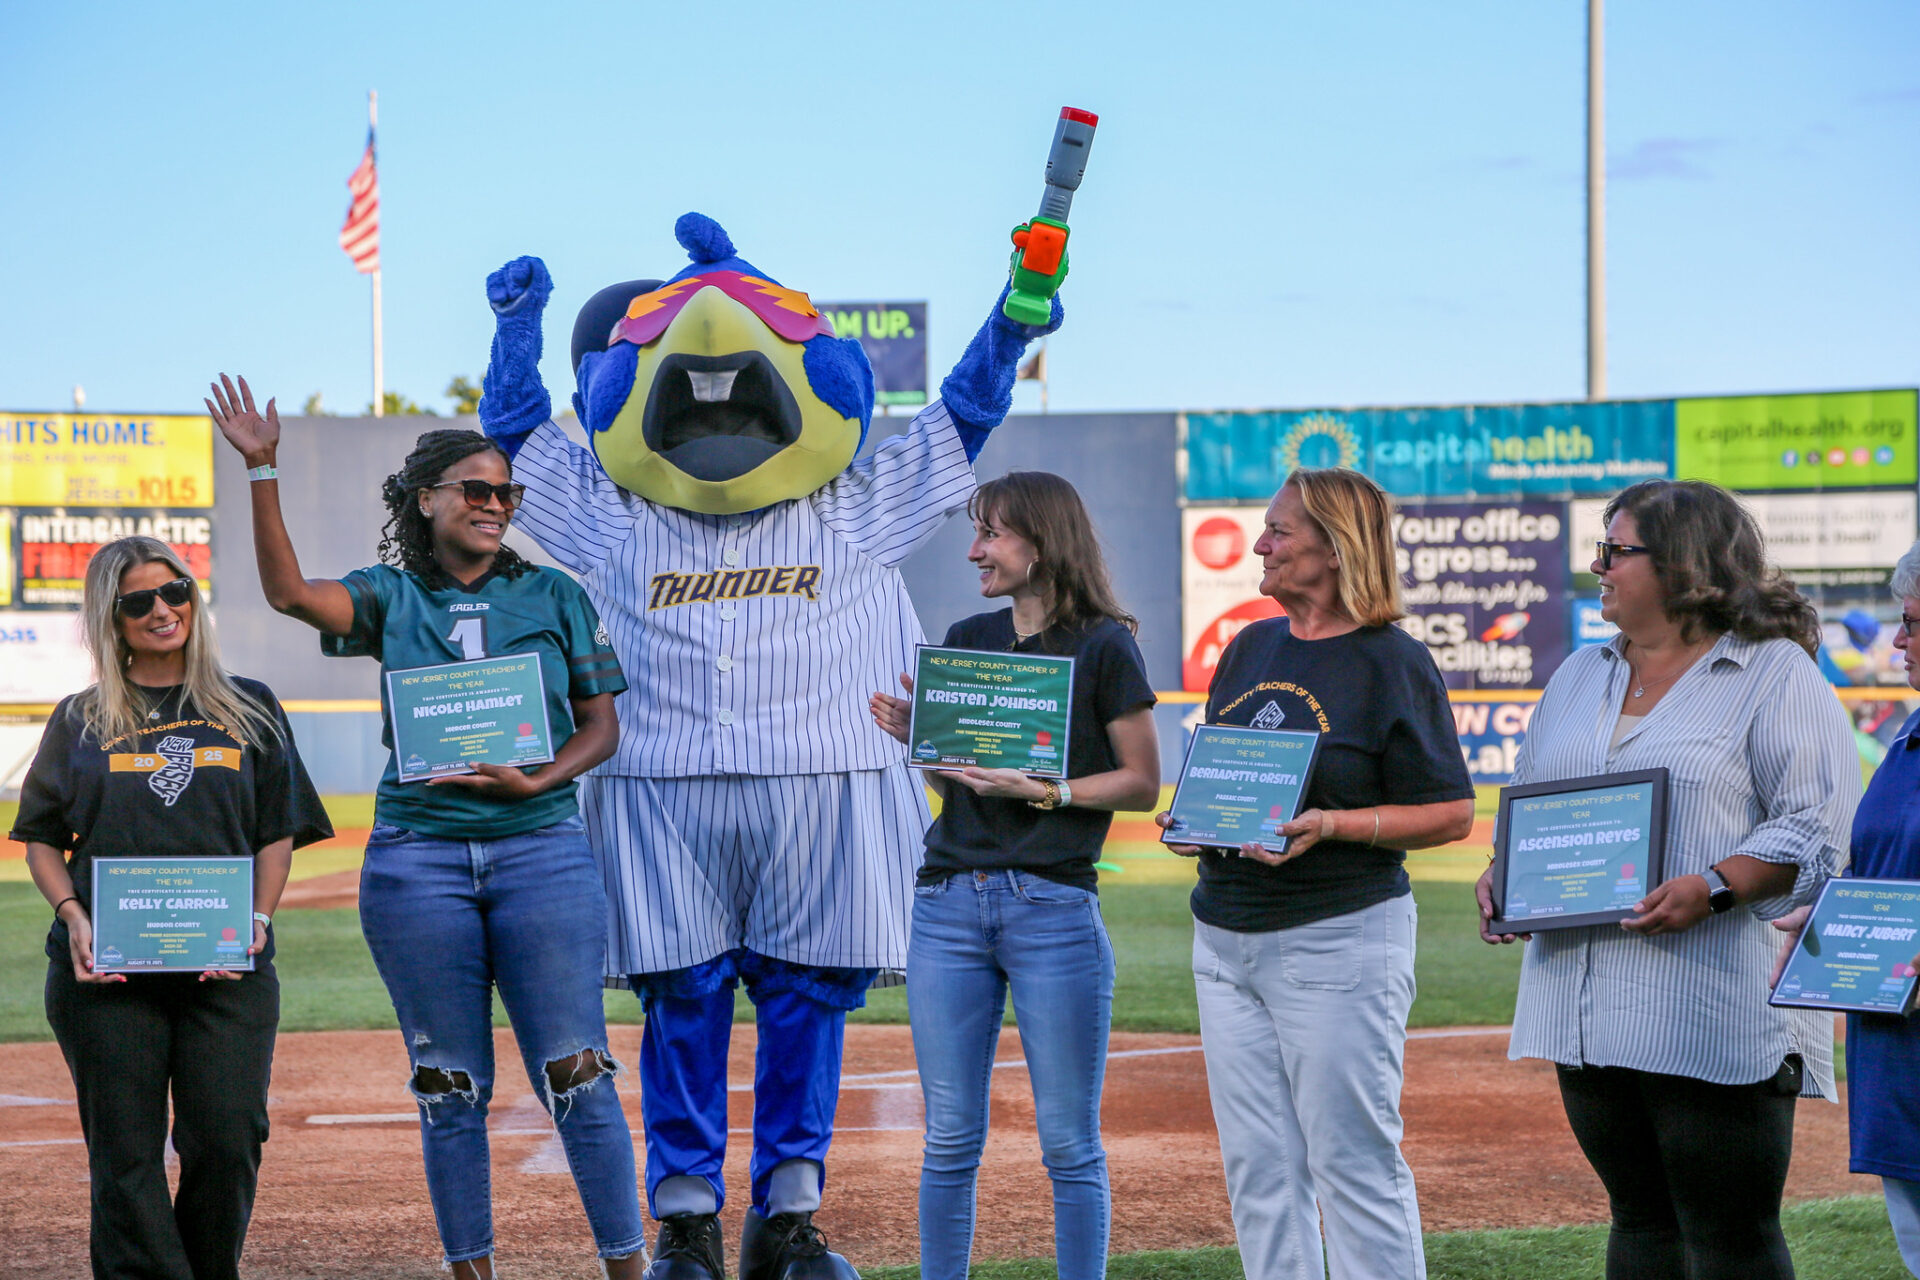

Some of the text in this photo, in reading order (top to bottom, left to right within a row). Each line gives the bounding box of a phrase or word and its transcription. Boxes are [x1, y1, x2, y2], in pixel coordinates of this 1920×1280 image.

[867, 310, 915, 339] UP.
[73, 422, 165, 445] HOME.
[1462, 508, 1560, 542] office
[1412, 545, 1537, 581] gross...
[648, 566, 822, 611] THUNDER
[449, 602, 490, 613] EAGLES
[447, 617, 487, 660] 1
[930, 657, 949, 665] NEW
[950, 659, 978, 669] JERSEY
[979, 661, 1010, 671] COUNTY
[1012, 665, 1047, 674] TEACHER
[402, 676, 420, 685] NEW
[422, 674, 448, 683] JERSEY
[449, 670, 480, 679] COUNTY
[481, 666, 516, 675] TEACHER
[975, 672, 1013, 683] THE YEAR
[465, 680, 485, 688] YEAR
[1219, 681, 1331, 733] COUNTY TEACHERS OF THE YEAR
[137, 720, 189, 736] TEACHERS
[206, 722, 227, 732] THE
[159, 736, 195, 751] NEW
[1205, 735, 1304, 750] NEW JERSEY COUNTY TEACHER OF
[204, 750, 223, 761] 25
[1236, 749, 1266, 758] THE YEAR
[133, 757, 155, 767] 20
[1523, 792, 1641, 812] NEW JERSEY COUNTY ESP OF THE
[1571, 810, 1591, 819] YEAR
[129, 867, 157, 875] JERSEY
[158, 867, 190, 875] COUNTY
[192, 867, 227, 875] TEACHER
[1835, 889, 1850, 897] NEW
[1875, 891, 1901, 900] COUNTY
[165, 898, 229, 909] CARROLL
